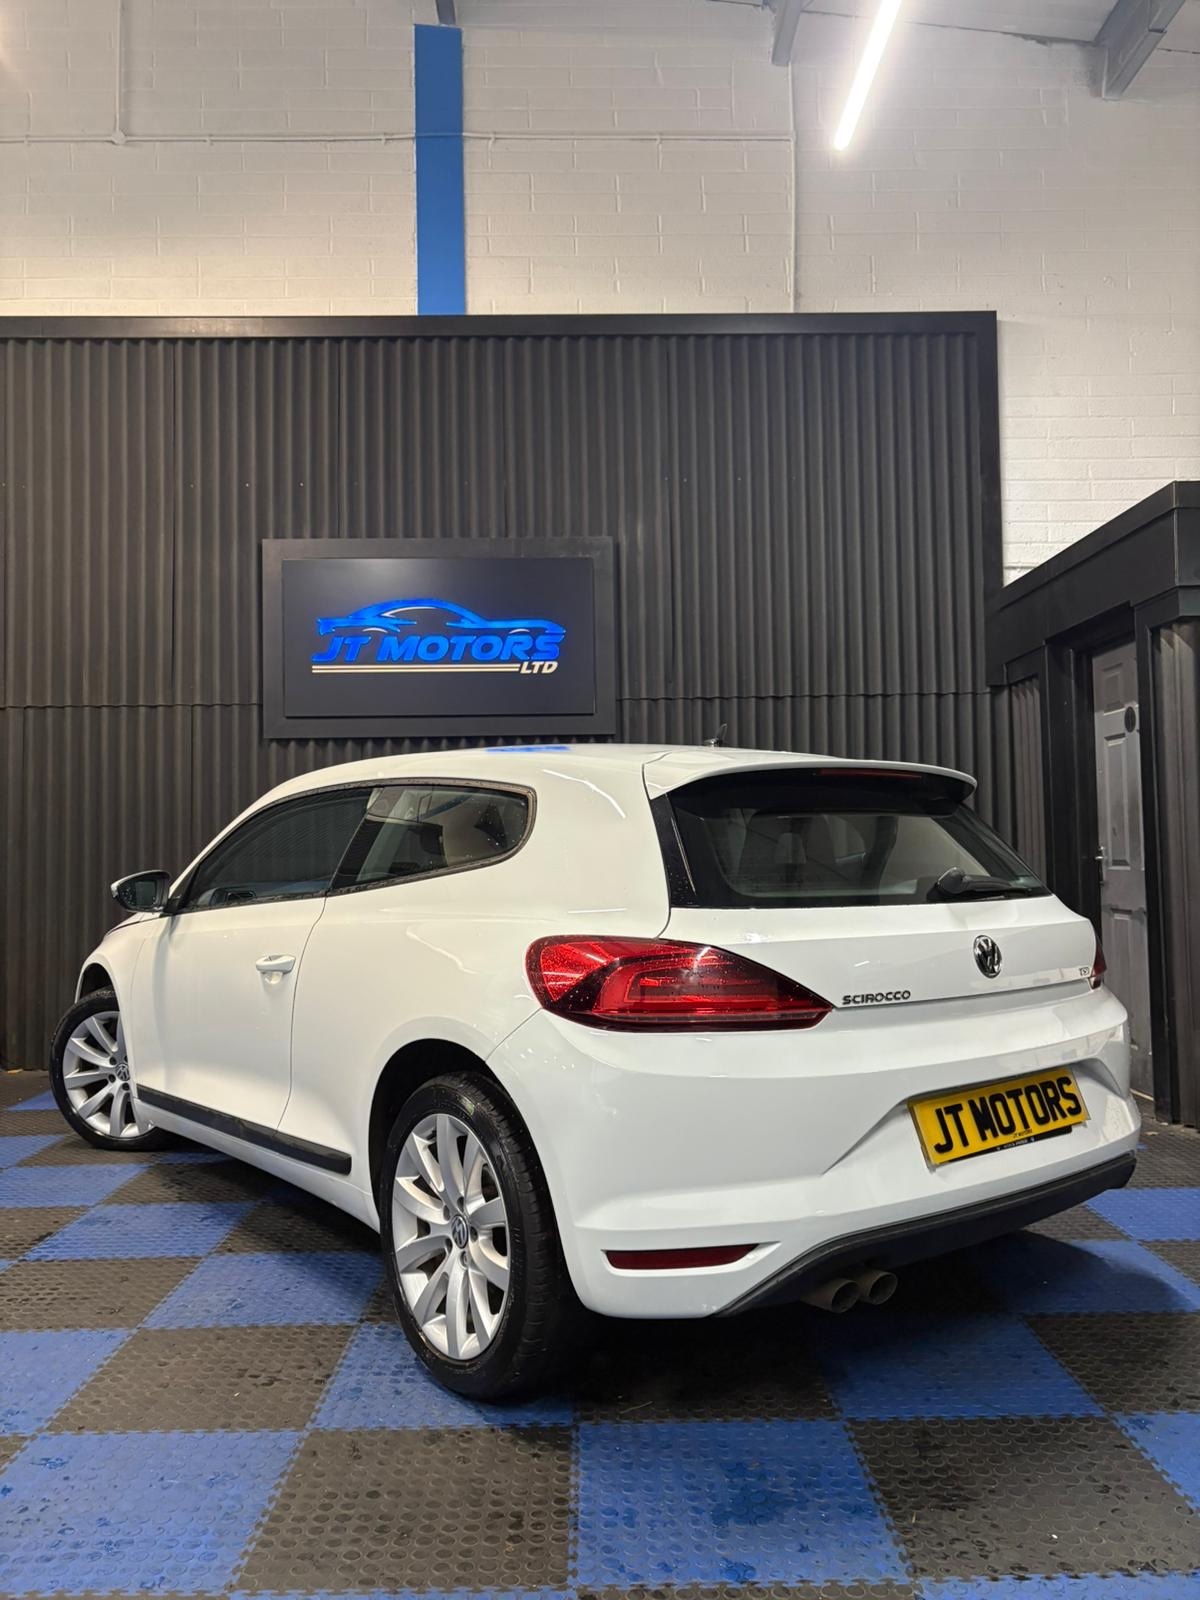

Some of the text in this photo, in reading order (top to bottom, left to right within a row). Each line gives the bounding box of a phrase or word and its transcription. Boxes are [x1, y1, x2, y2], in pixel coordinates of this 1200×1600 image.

[312, 634, 564, 662] JT MOTORS
[520, 661, 558, 674] LTD
[842, 990, 911, 1006] SCIROCCO
[934, 1076, 1082, 1154] JT MOTORS
